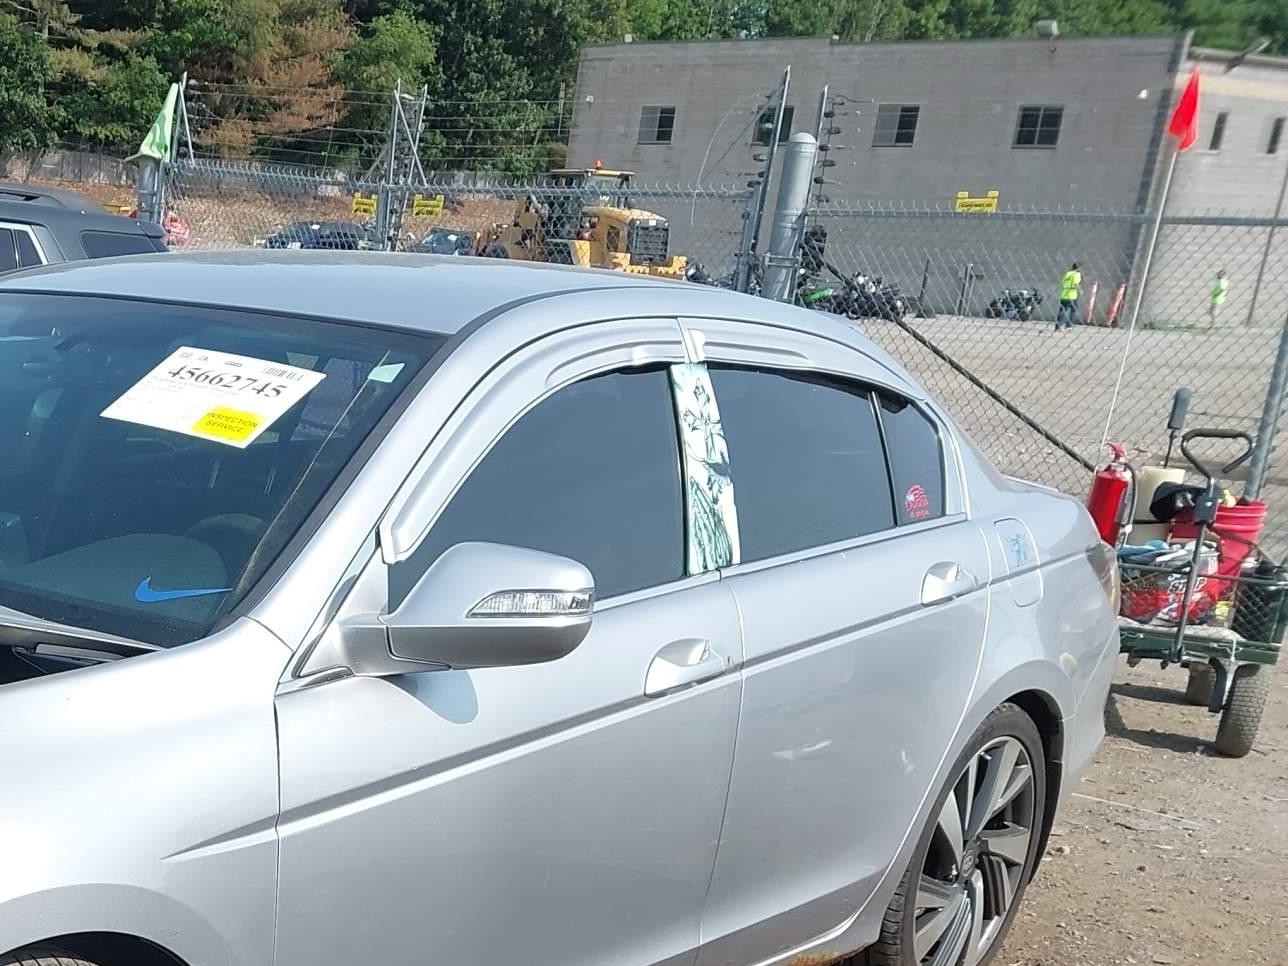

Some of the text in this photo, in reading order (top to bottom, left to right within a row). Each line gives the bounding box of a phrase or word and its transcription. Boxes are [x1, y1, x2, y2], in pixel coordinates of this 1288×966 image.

[168, 365, 288, 398] 45662745
[206, 411, 258, 428] INSPECTION
[206, 421, 245, 433] SERVICE
